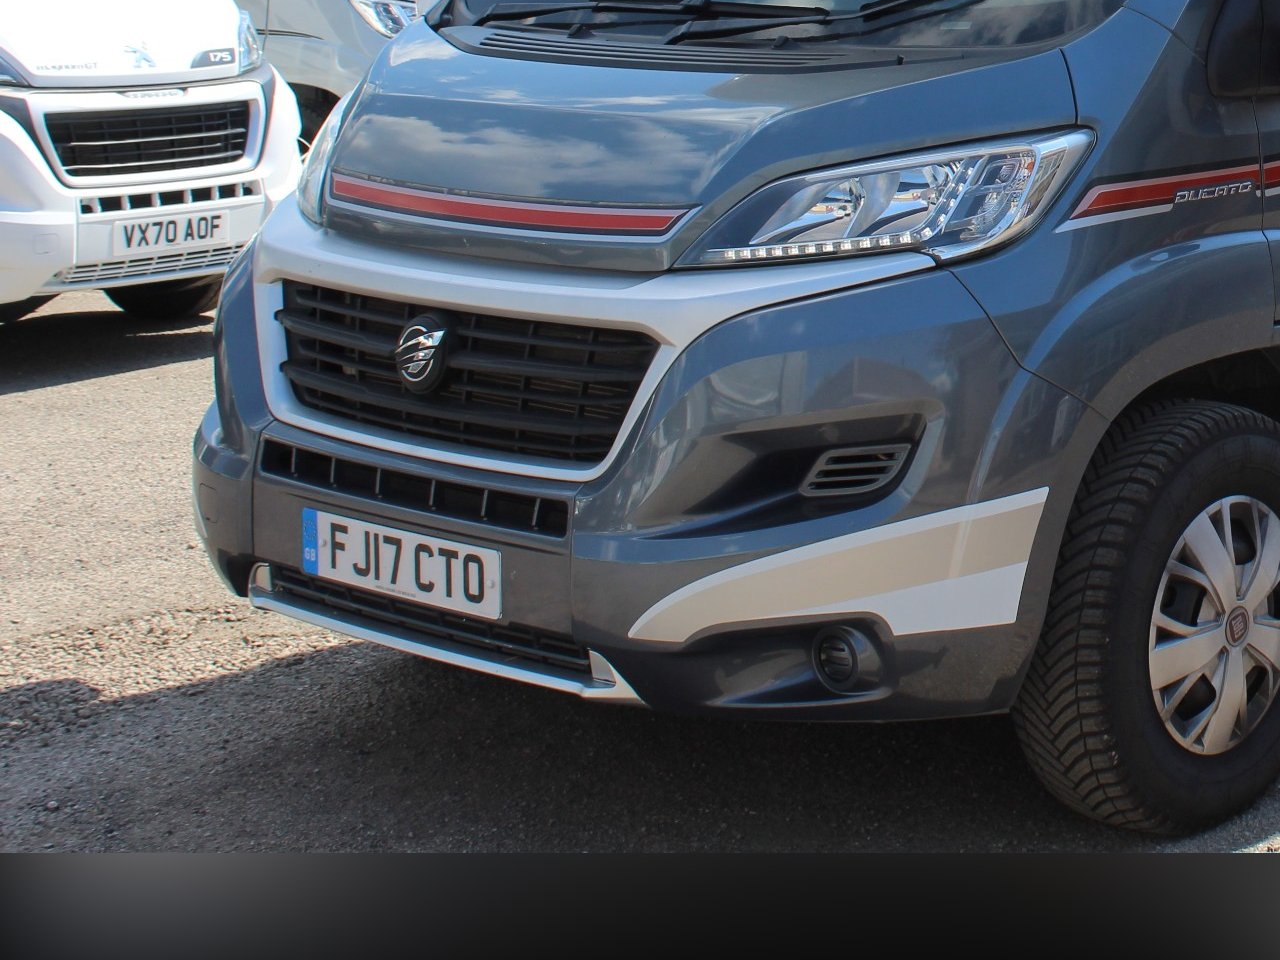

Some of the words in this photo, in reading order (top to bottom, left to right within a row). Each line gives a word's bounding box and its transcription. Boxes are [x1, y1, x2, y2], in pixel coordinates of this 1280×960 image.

[209, 51, 231, 62] 175
[1175, 181, 1252, 203] DUCATO
[124, 220, 177, 248] VX70
[184, 215, 222, 241] AOF
[304, 547, 316, 561] GB
[331, 522, 402, 585] FJ17
[415, 543, 485, 604] CTO
